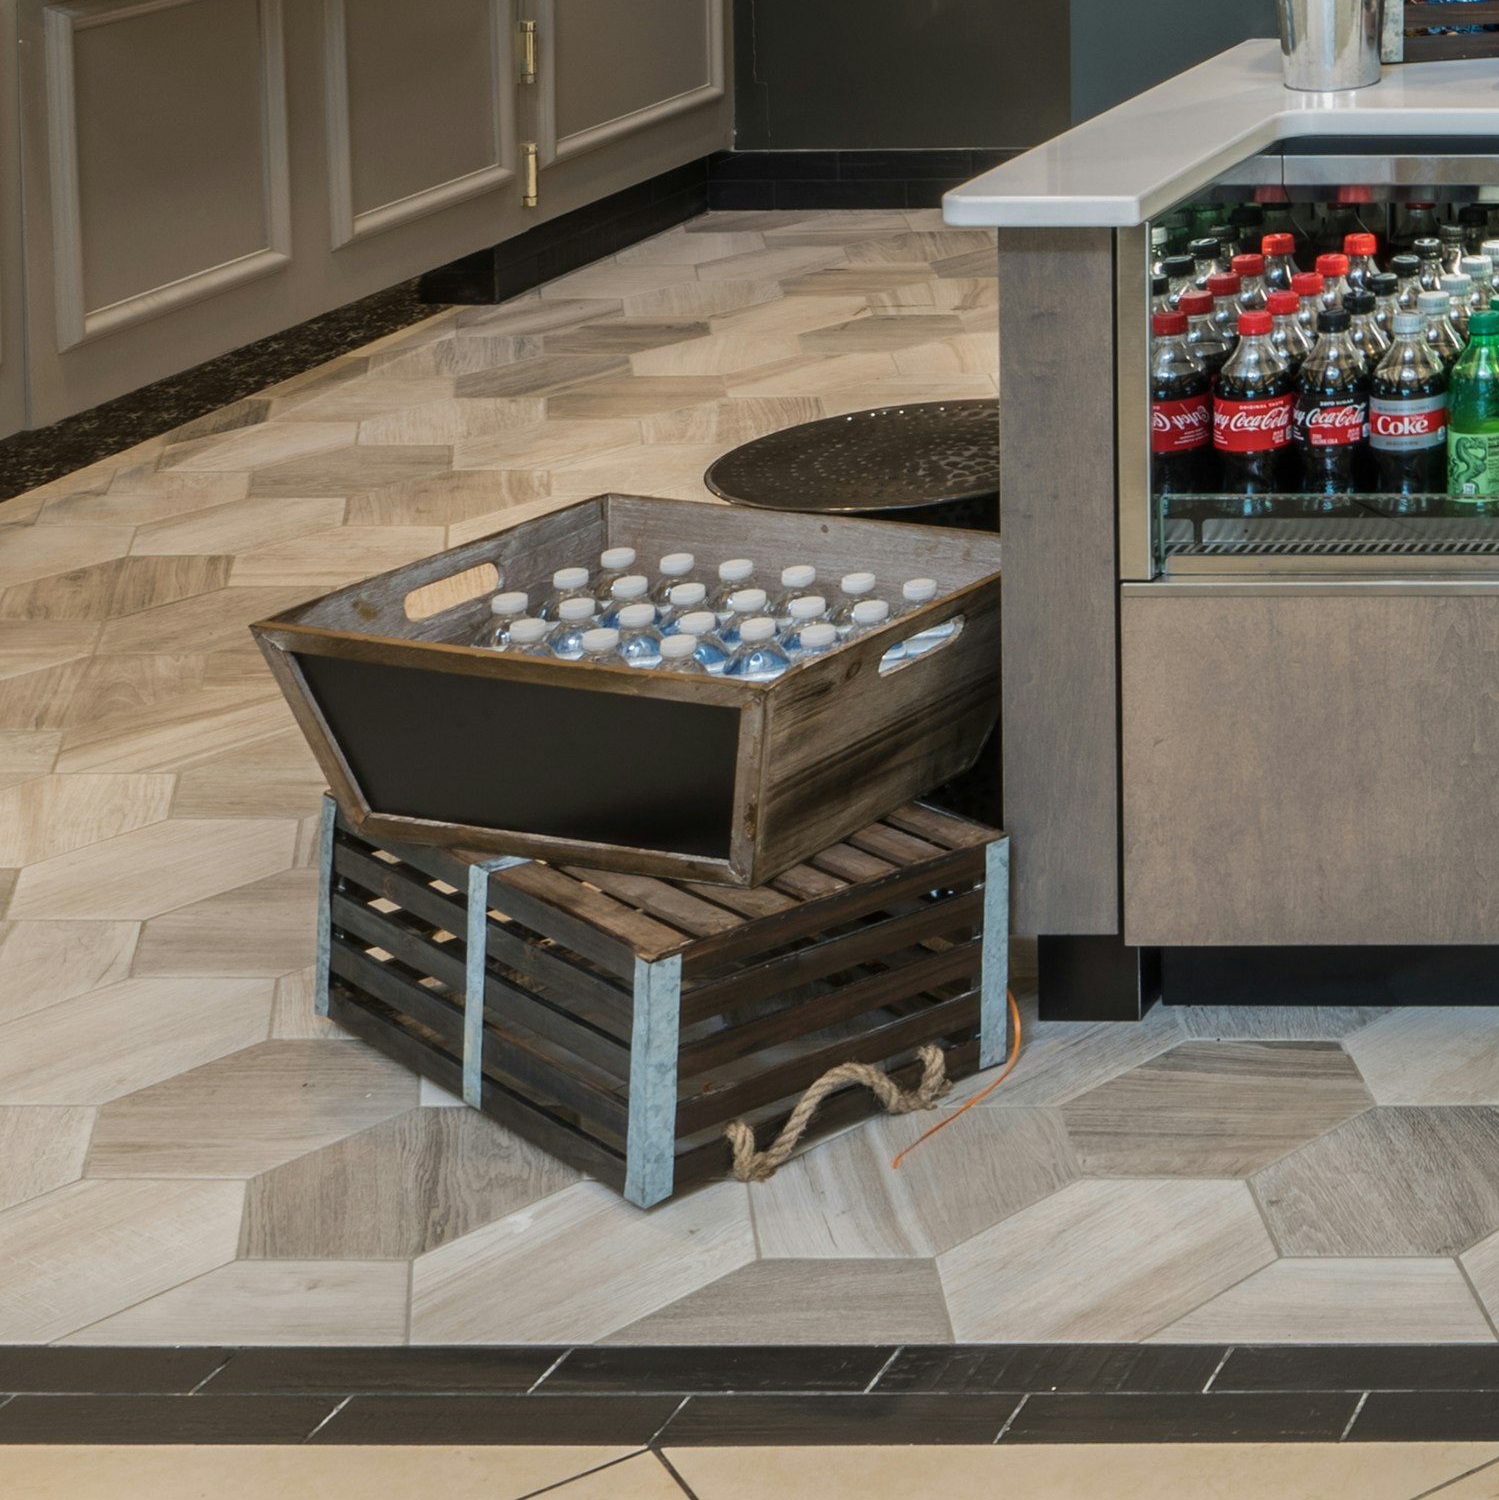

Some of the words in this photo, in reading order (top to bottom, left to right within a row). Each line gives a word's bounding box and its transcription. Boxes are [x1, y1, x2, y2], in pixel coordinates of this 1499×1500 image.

[1230, 405, 1290, 432] Coca-Cola
[1305, 402, 1367, 428] Coca-Cola
[1376, 414, 1429, 436] Coke
